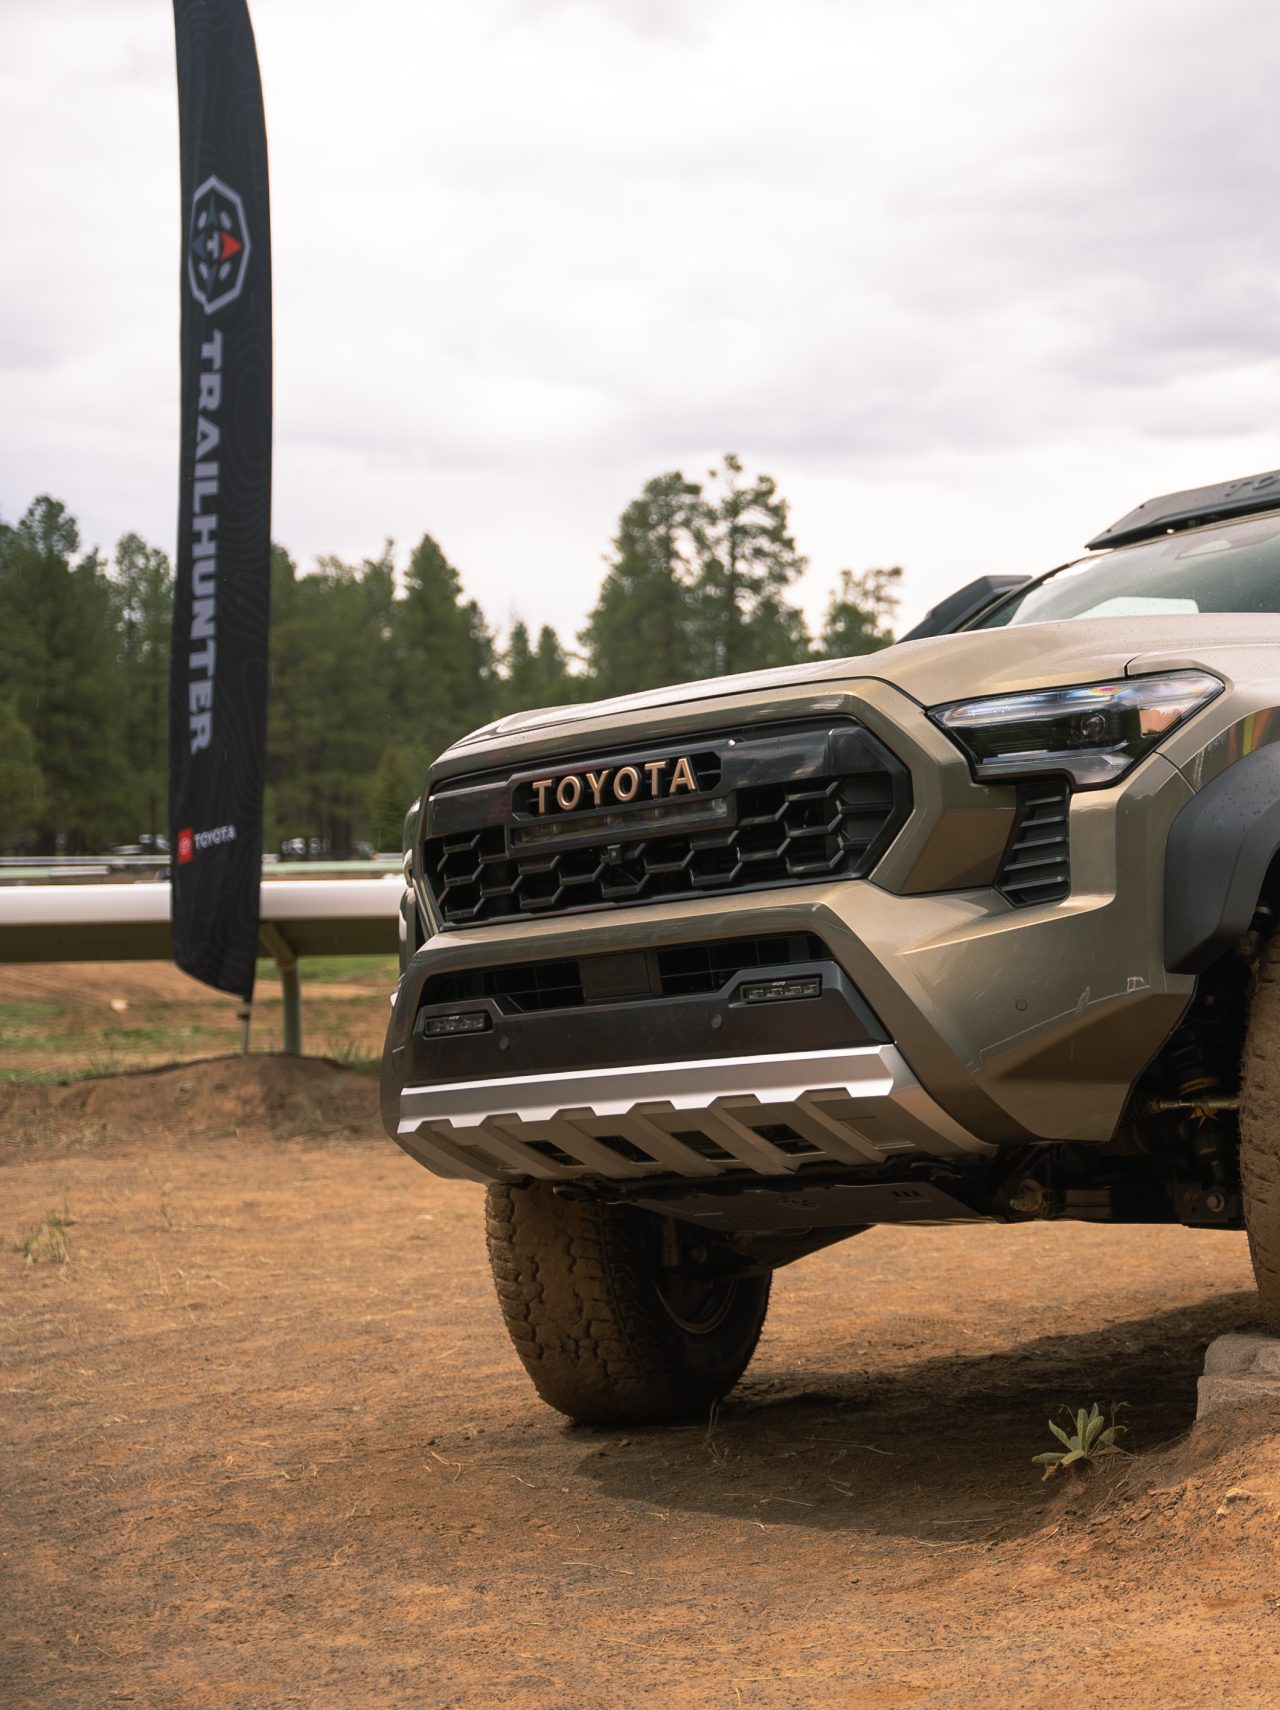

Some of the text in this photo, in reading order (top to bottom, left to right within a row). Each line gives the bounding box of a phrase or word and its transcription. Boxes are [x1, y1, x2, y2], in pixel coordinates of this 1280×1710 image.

[189, 328, 222, 755] TRAILHUNTER
[532, 756, 698, 814] TOYOTA
[194, 824, 237, 850] TOYOTA
